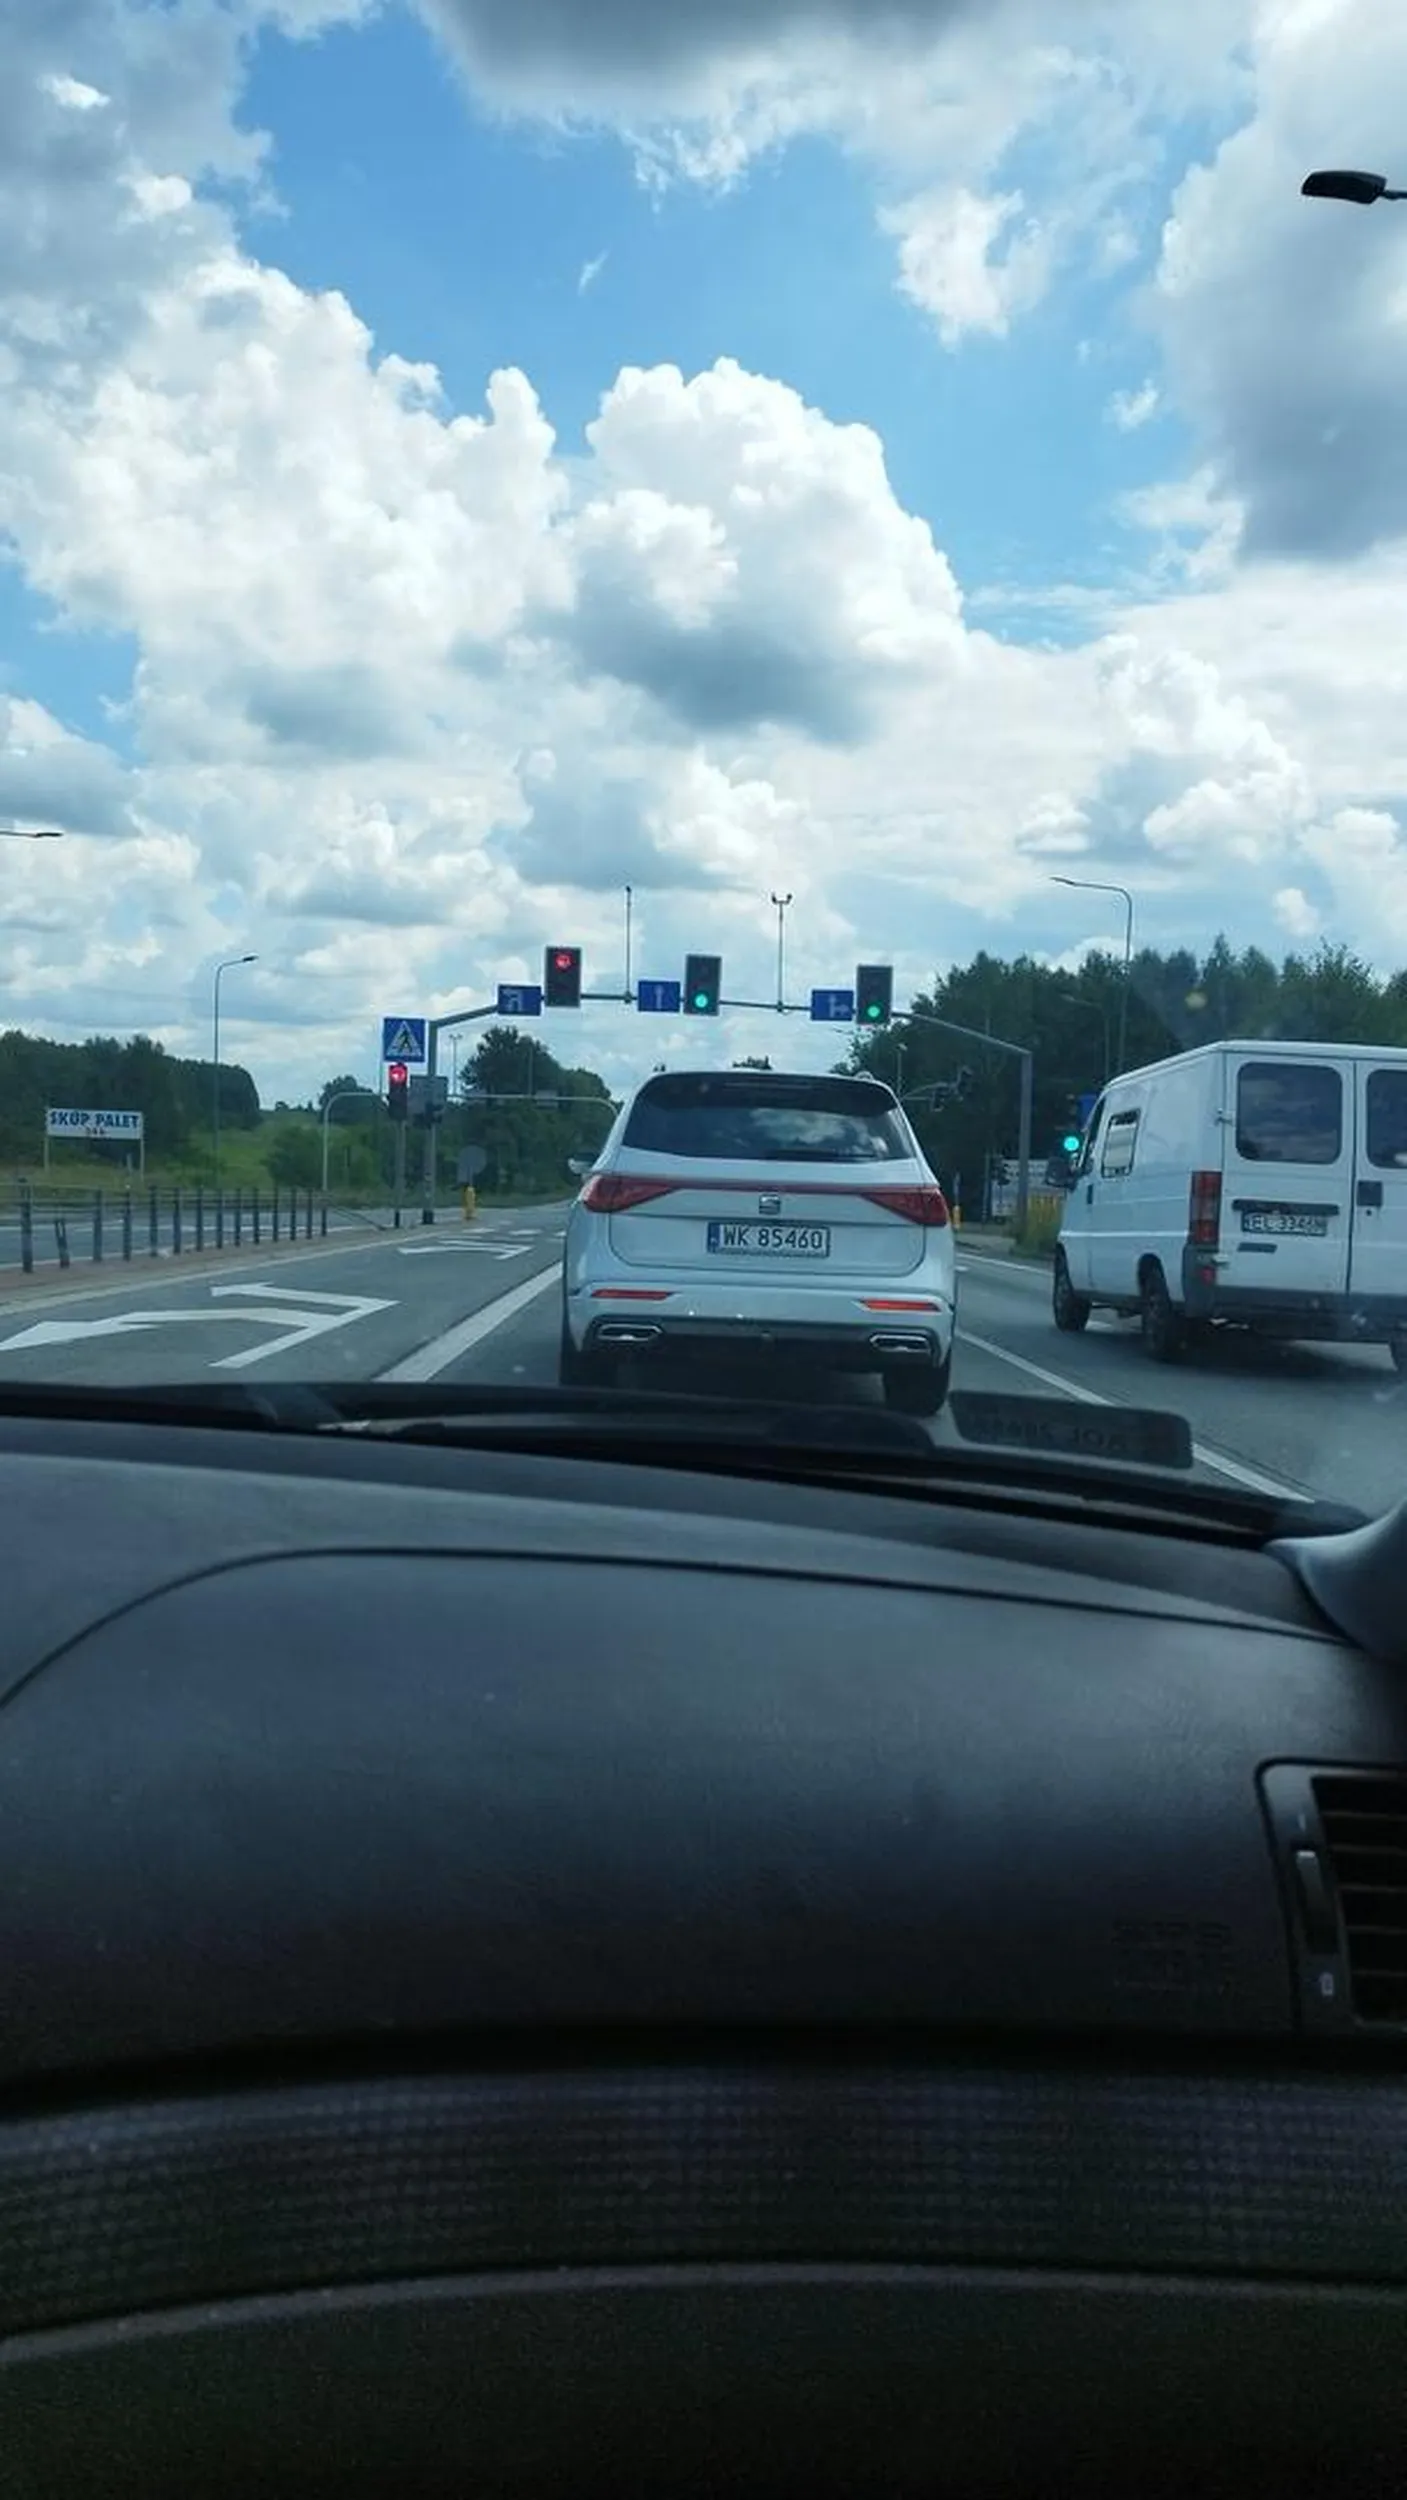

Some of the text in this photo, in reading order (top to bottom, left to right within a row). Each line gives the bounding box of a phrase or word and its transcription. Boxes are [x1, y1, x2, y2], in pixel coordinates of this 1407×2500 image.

[95, 1113, 139, 1129] PALET
[724, 1225, 749, 1247] WK
[758, 1228, 823, 1249] 85460
